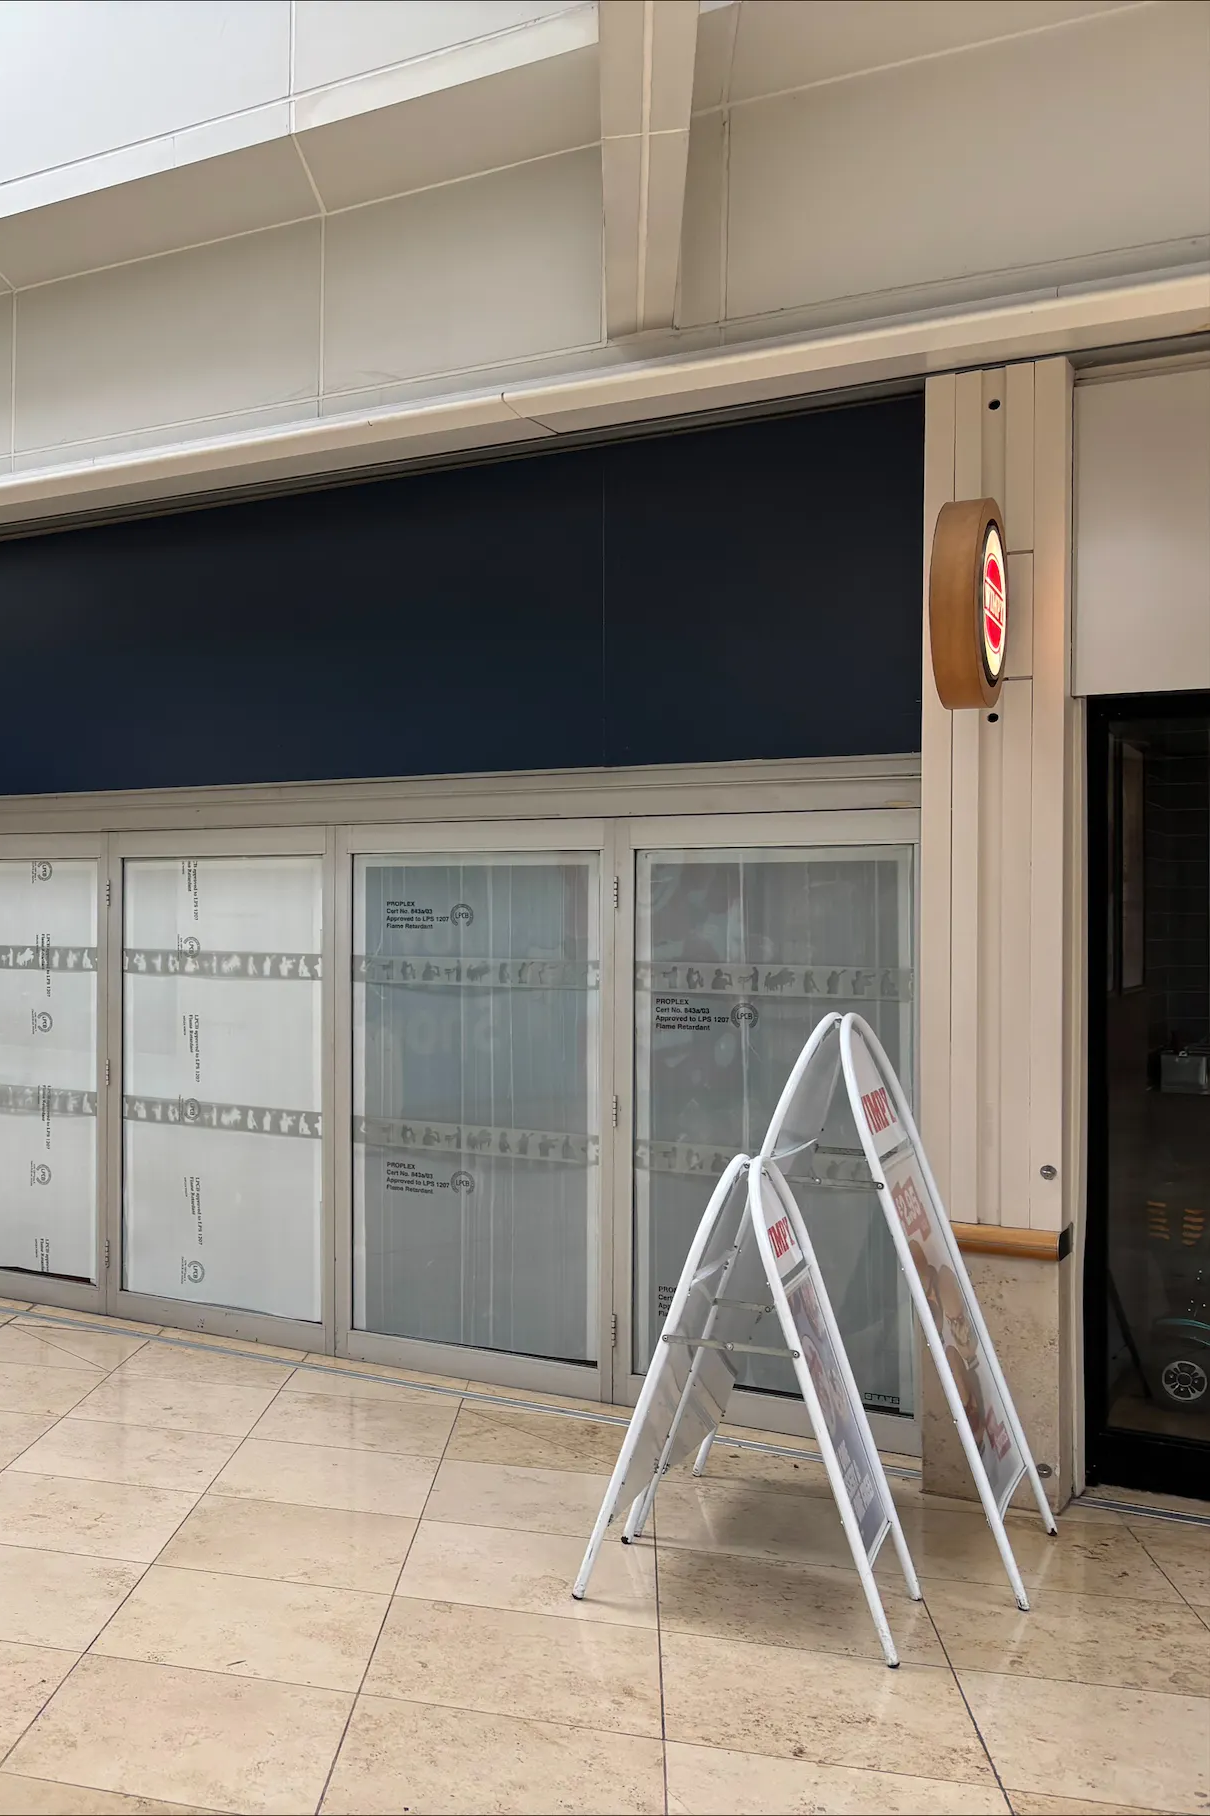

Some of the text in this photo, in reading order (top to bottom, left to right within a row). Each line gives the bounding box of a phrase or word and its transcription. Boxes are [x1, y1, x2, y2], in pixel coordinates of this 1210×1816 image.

[678, 1023, 710, 1031] Retardant
[387, 1162, 415, 1170] PROPLEX
[386, 1177, 414, 1185] Approved
[405, 1186, 434, 1194] Retardant
